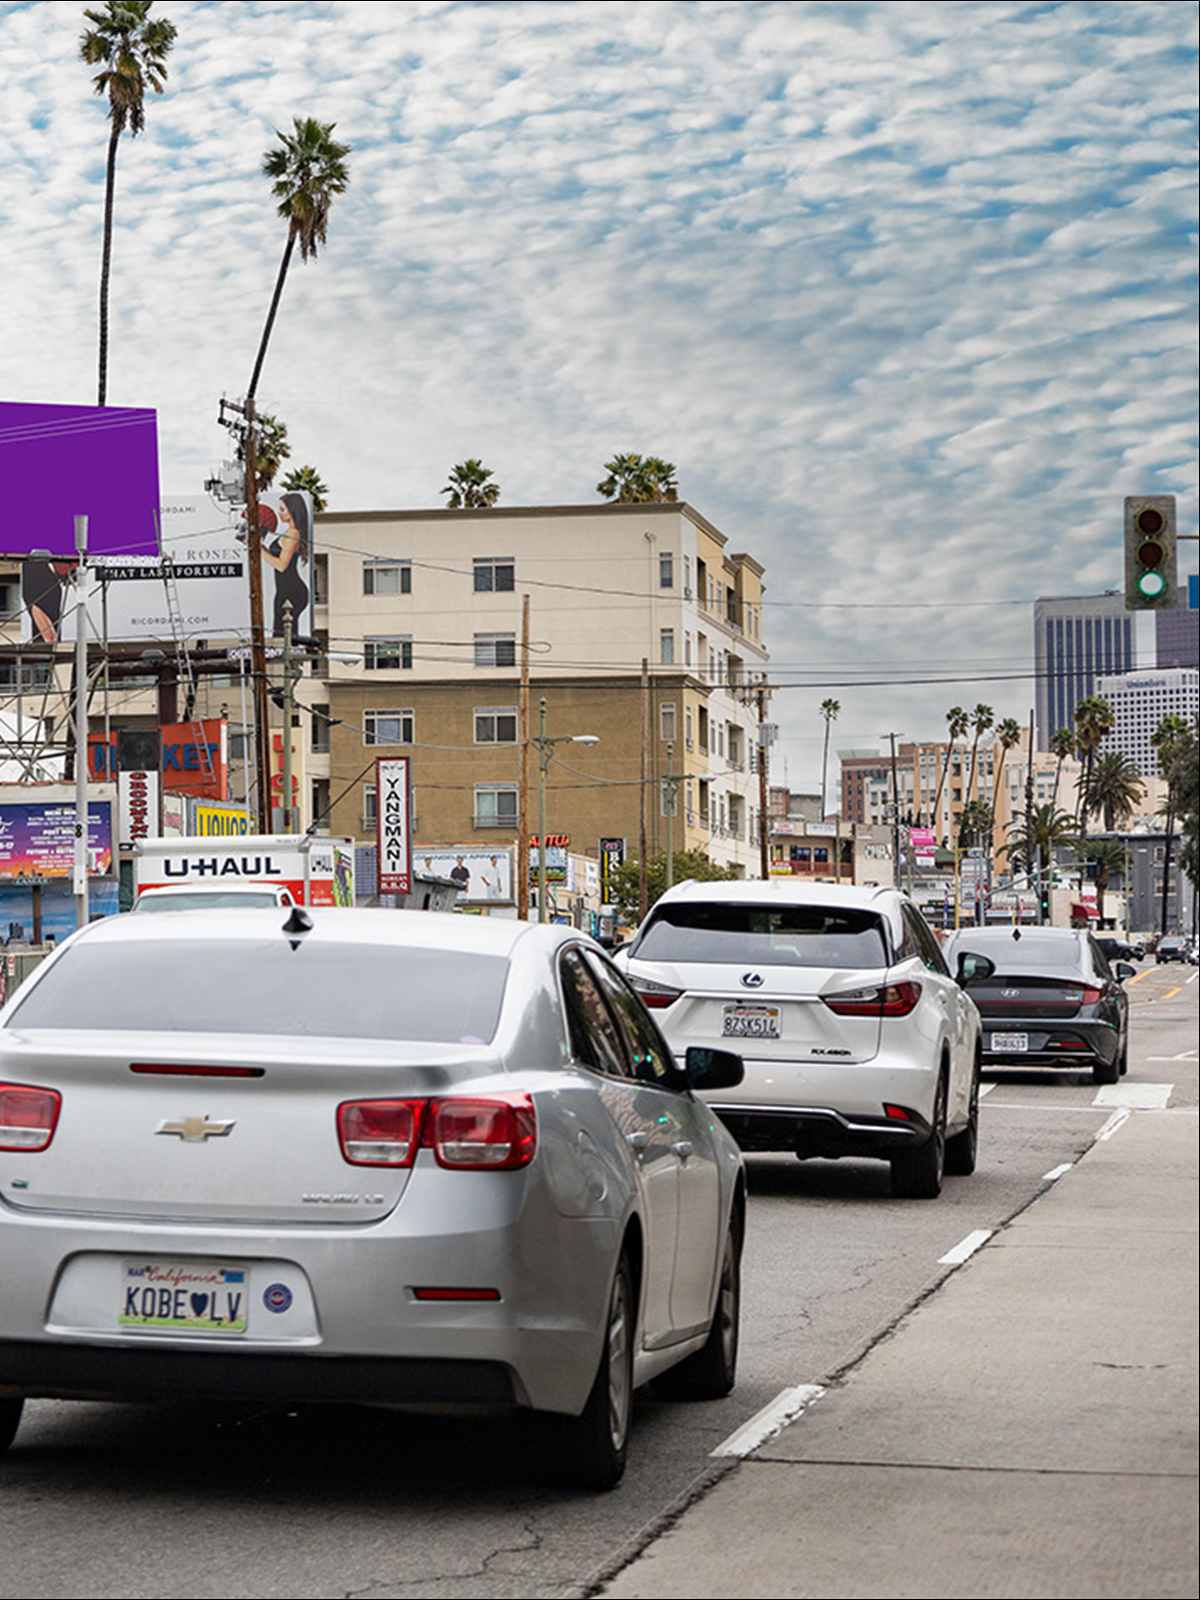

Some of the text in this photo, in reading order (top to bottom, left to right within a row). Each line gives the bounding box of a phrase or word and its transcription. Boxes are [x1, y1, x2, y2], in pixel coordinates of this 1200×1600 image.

[187, 548, 241, 560] ROSES
[140, 567, 172, 578] LAST
[176, 565, 236, 577] FOREVER
[131, 616, 209, 625] RICORDAMI.COM
[94, 743, 218, 772] MKET
[385, 778, 402, 872] YANGMANI
[164, 857, 281, 877] U-HAUL
[148, 1266, 226, 1287] California
